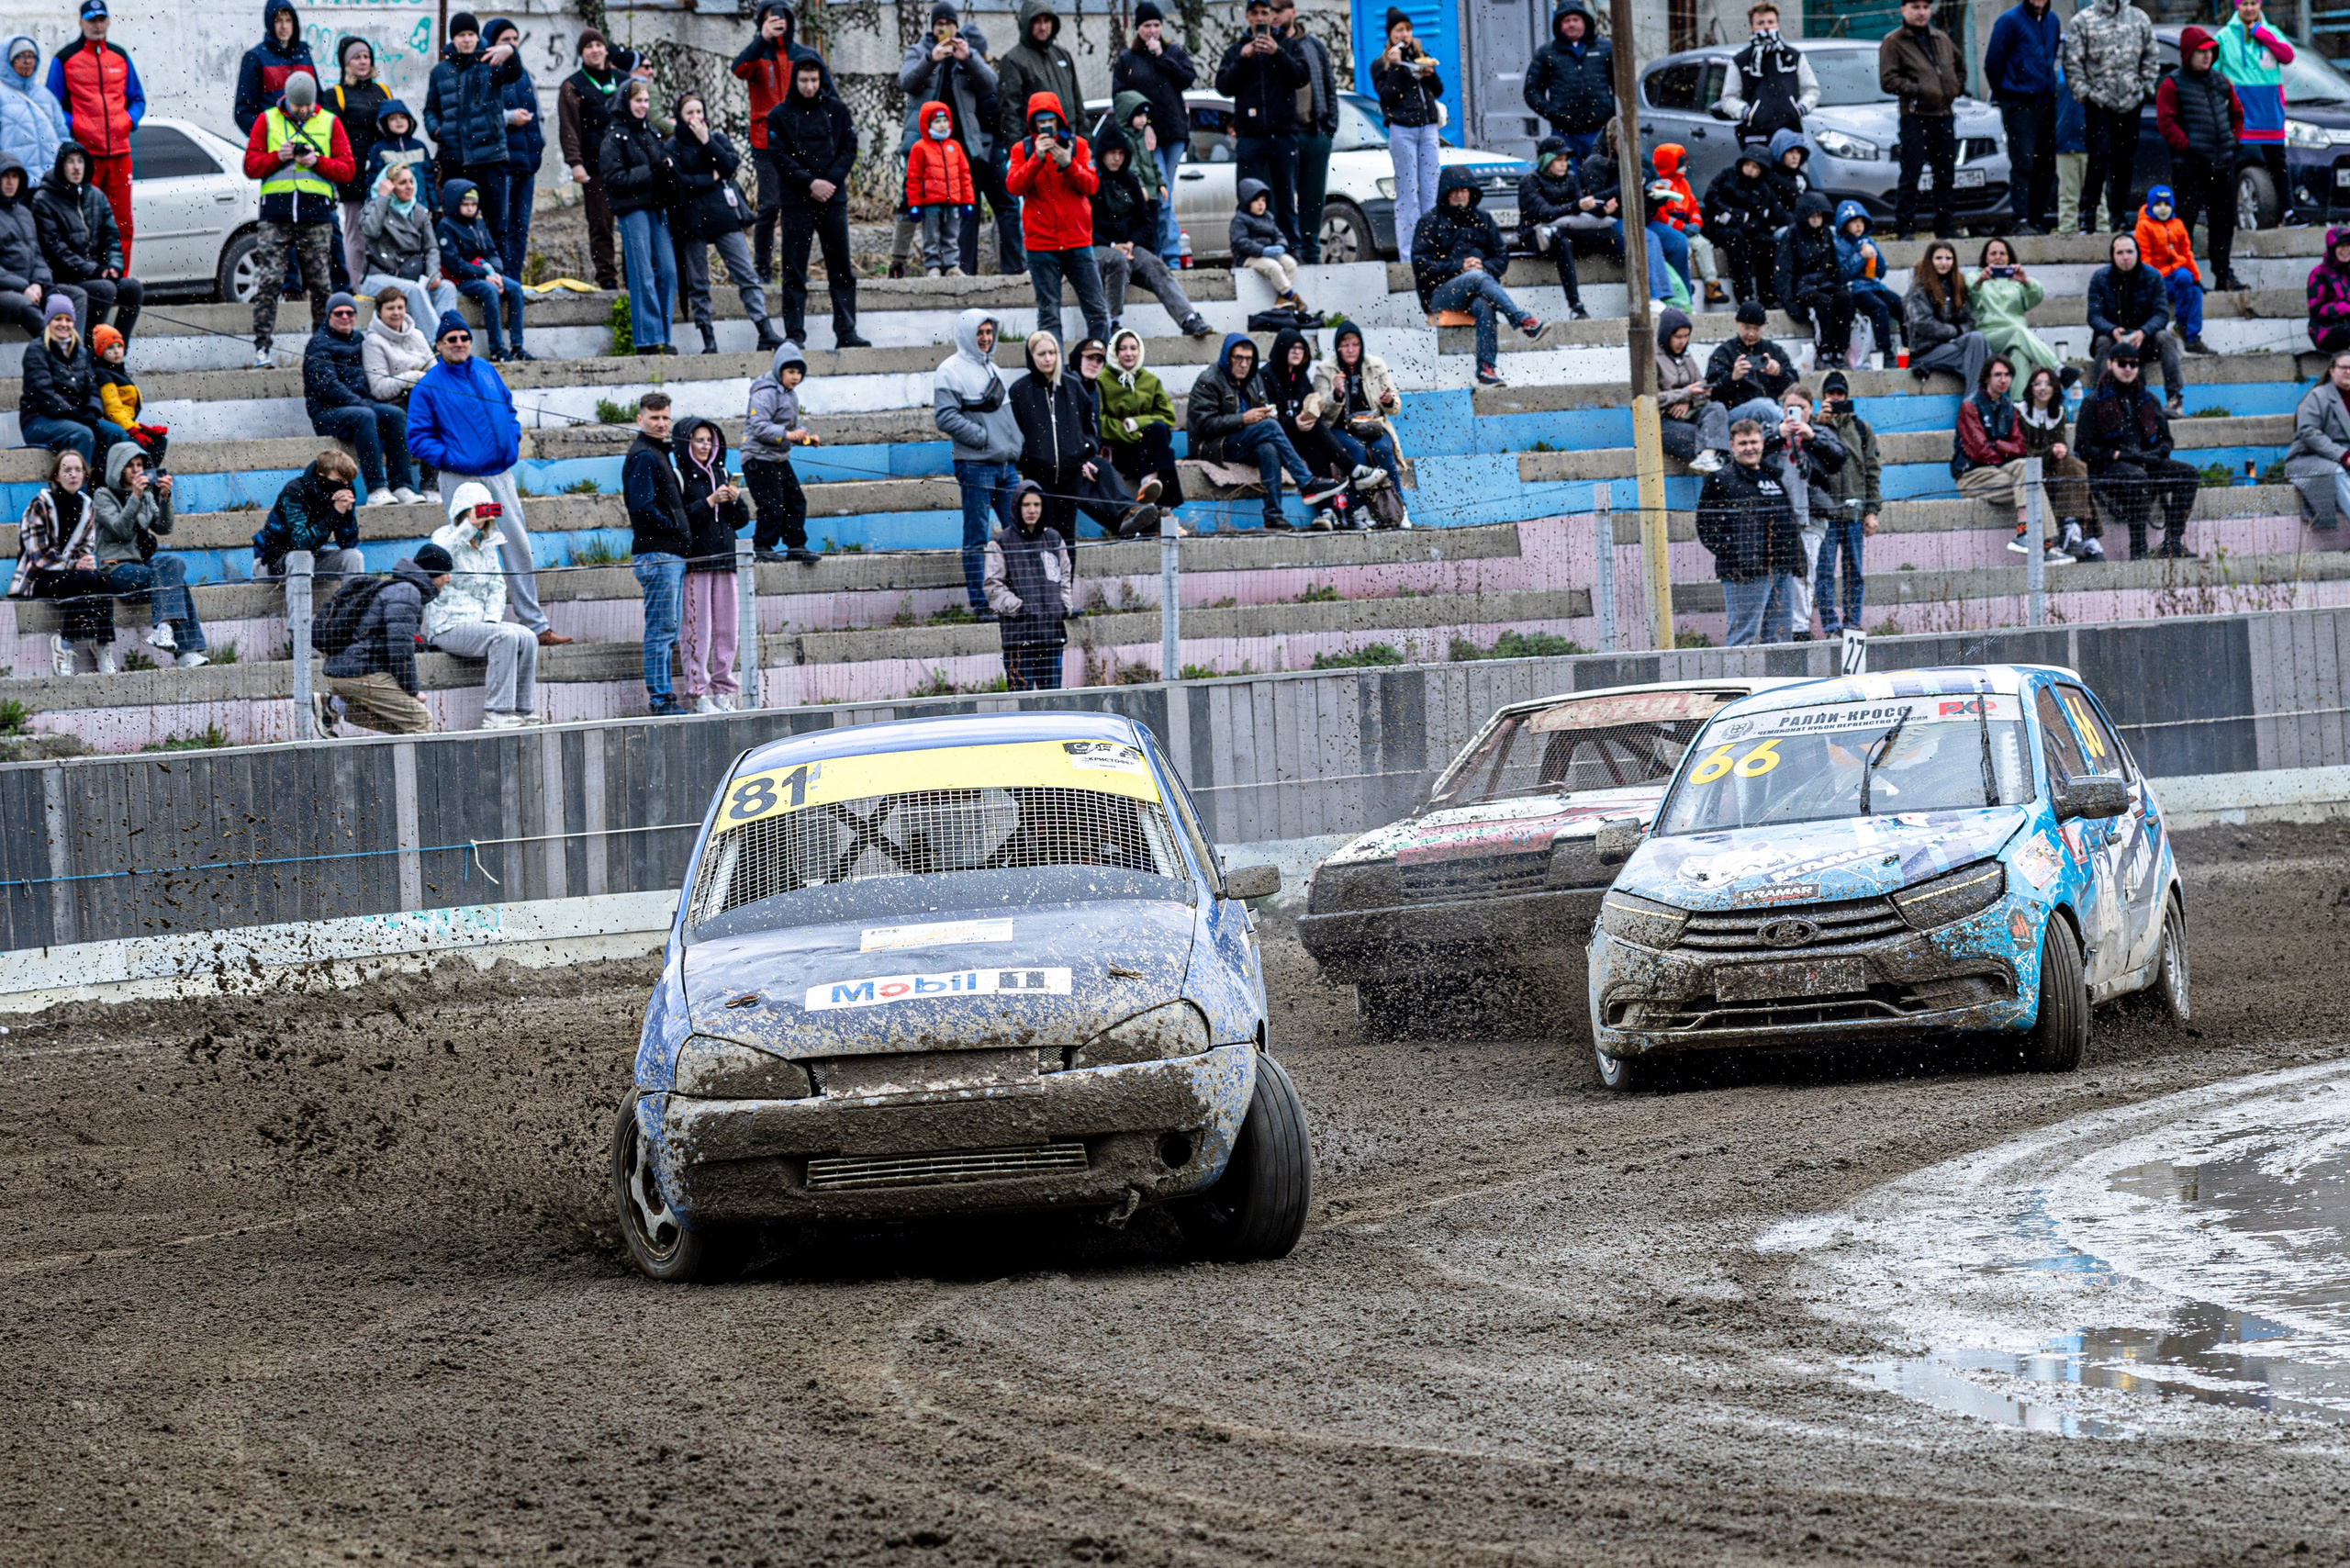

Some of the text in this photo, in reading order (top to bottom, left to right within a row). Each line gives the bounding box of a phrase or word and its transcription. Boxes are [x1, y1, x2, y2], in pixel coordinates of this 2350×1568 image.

[1842, 635, 1865, 675] 27
[1778, 706, 1913, 728] РАЛЛИ-КРОСС
[1836, 718, 1892, 729] ПЕРВЕНСТВО
[1893, 714, 1929, 723] РССИИ
[2064, 697, 2106, 758] 66
[1689, 737, 1783, 786] 66
[729, 765, 808, 821] 81
[1742, 885, 1813, 900] KRAMAR
[831, 972, 977, 1003] Mobil
